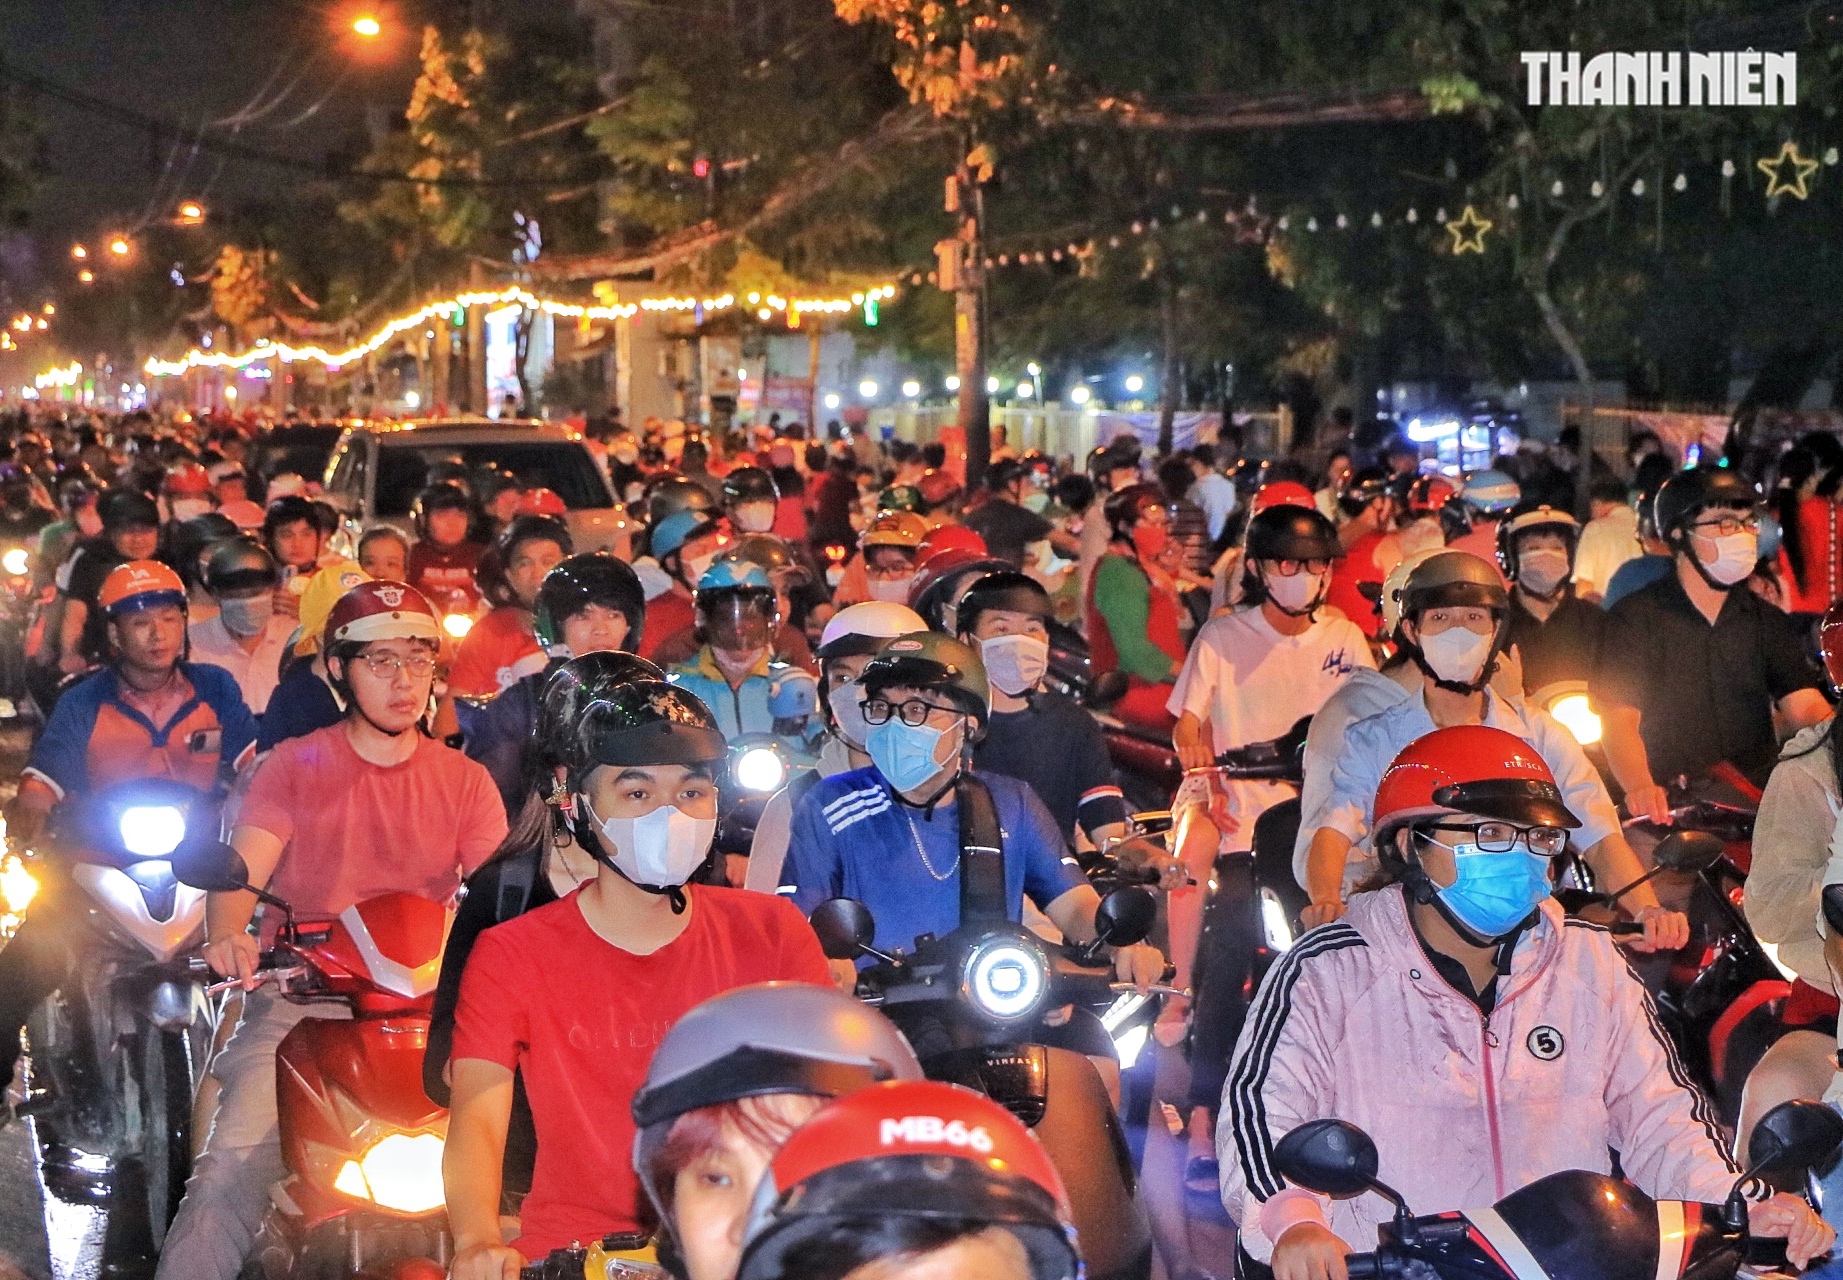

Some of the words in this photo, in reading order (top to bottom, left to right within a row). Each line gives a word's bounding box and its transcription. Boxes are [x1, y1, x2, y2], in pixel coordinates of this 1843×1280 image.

[1504, 761, 1543, 772] ETRSCA
[1536, 1032, 1556, 1053] 5
[880, 1116, 993, 1153] MB66
